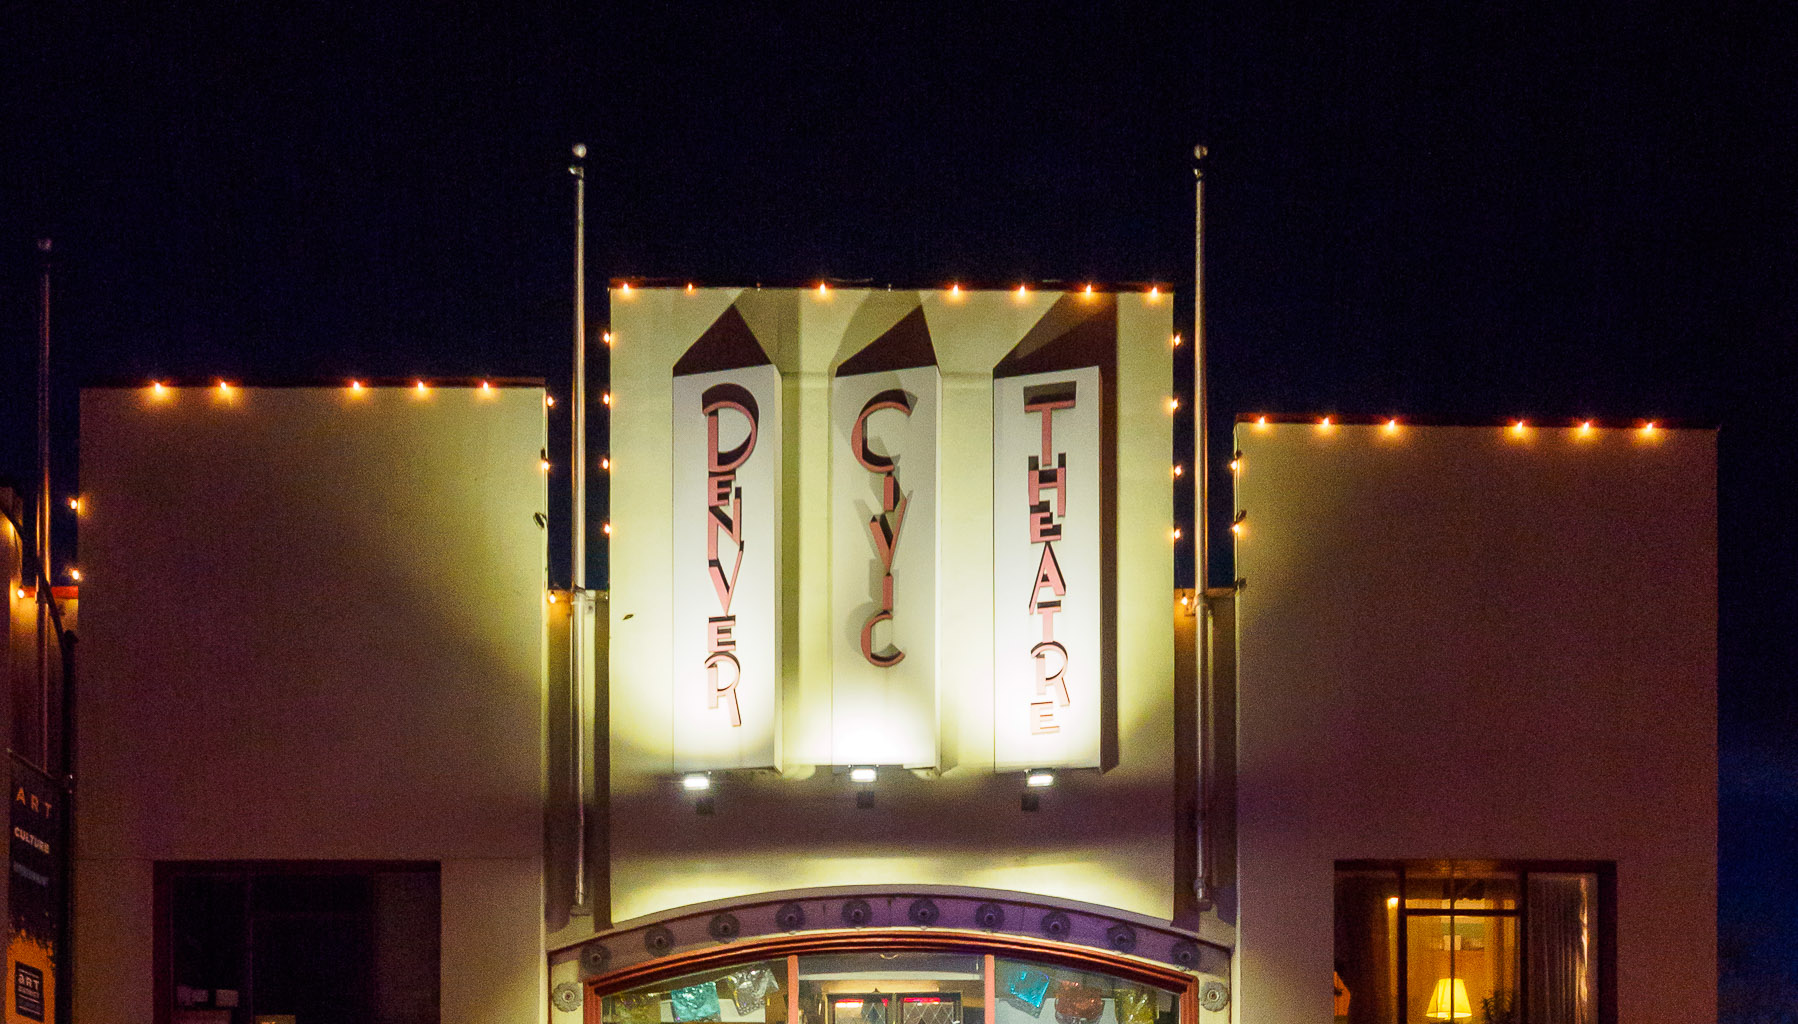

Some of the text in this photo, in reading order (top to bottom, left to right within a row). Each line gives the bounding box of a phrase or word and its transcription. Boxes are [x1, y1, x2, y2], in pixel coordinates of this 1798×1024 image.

[702, 386, 758, 727] DENVER
[852, 394, 912, 668] CIVIC
[1024, 390, 1077, 735] THEATRE
[16, 786, 53, 819] ART
